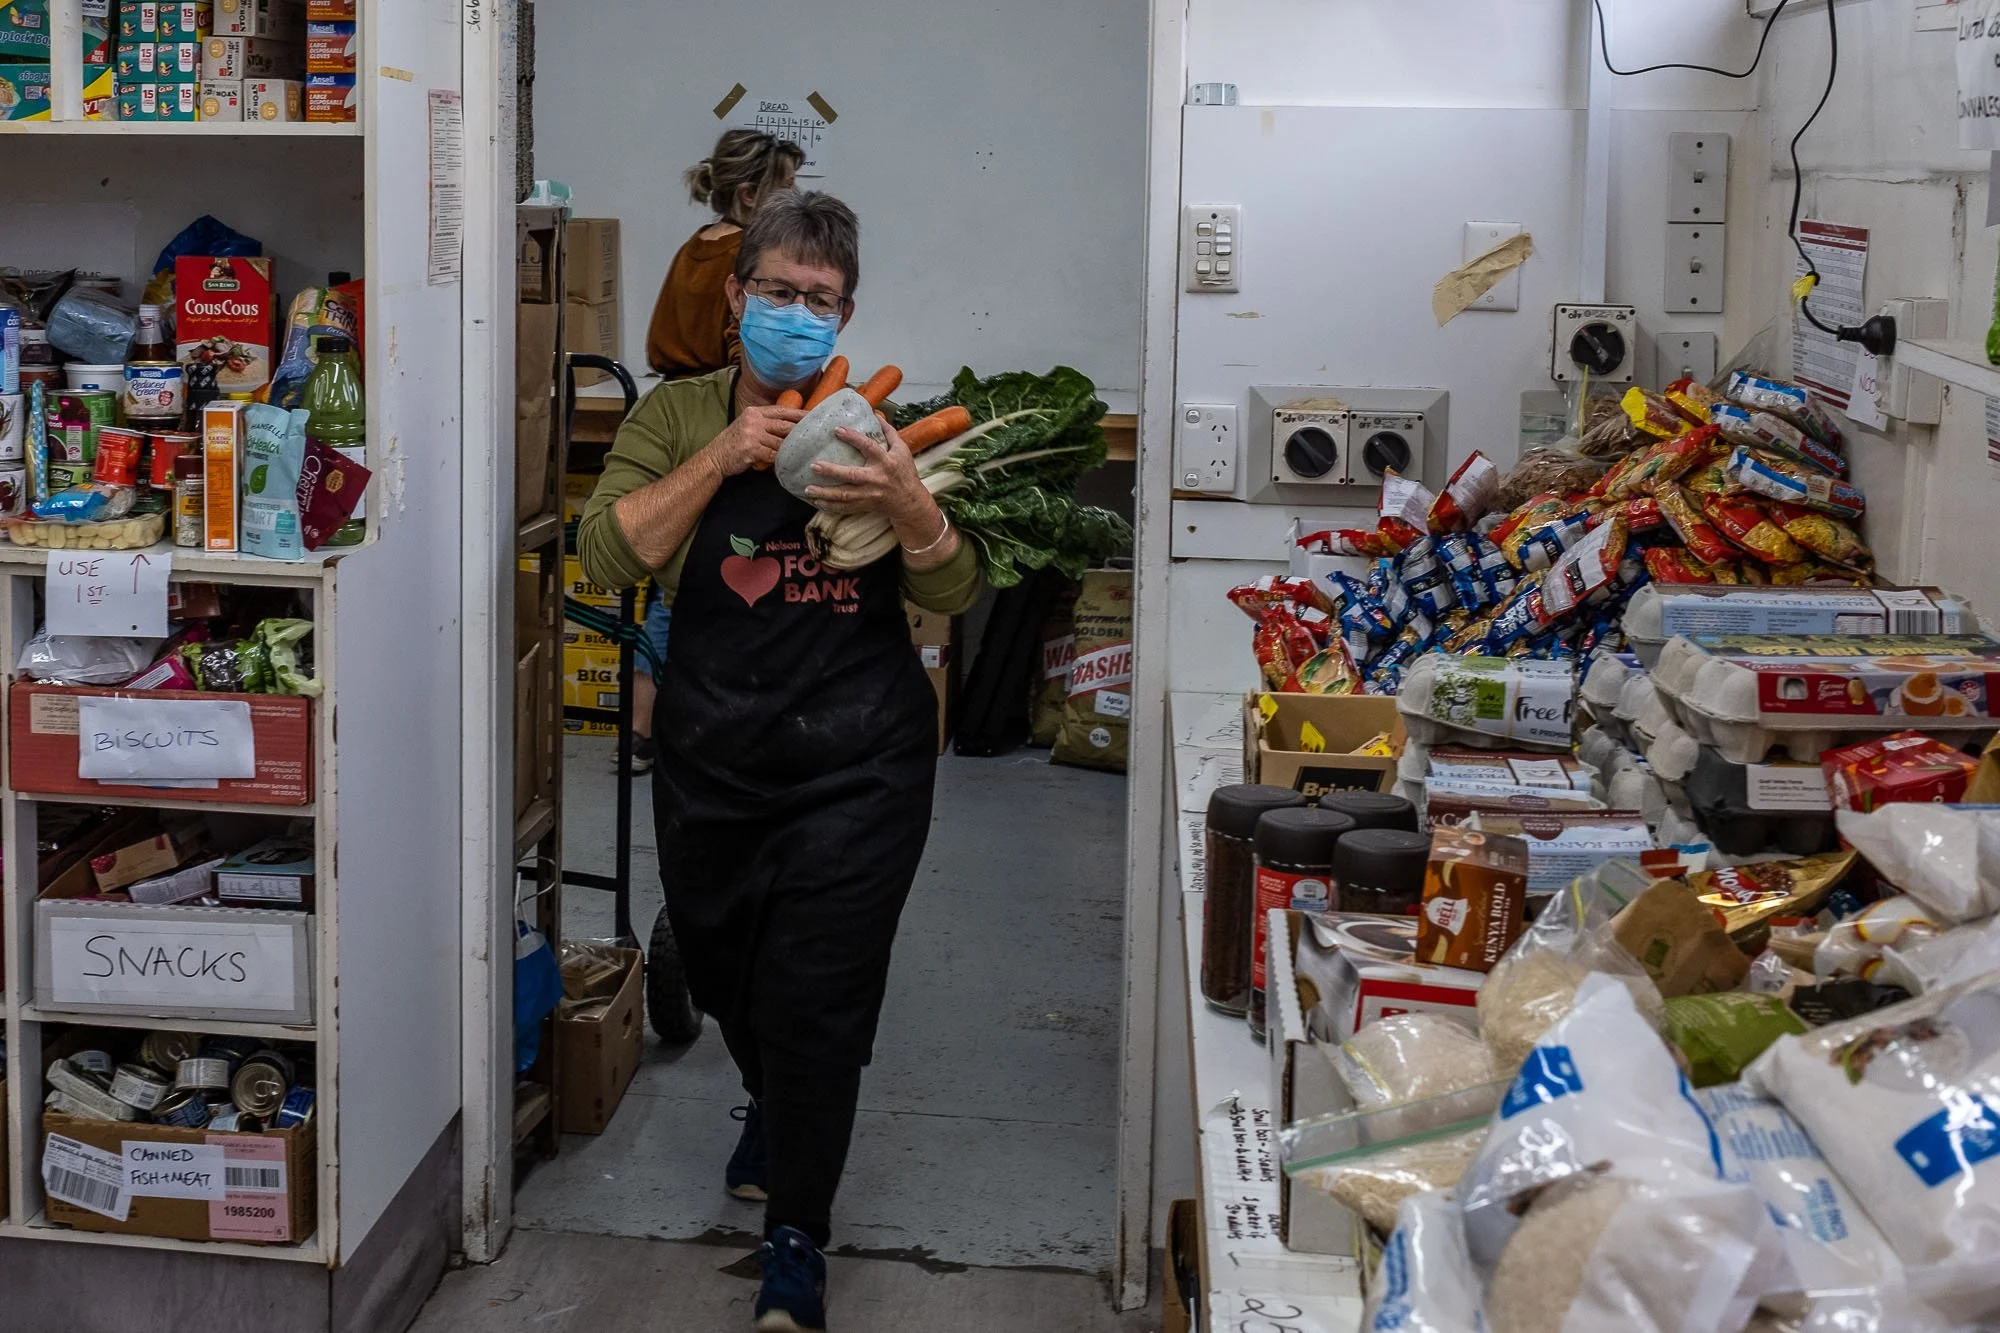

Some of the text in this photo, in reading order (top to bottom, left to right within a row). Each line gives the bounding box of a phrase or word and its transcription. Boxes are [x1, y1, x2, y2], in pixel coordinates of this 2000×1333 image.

[142, 8, 154, 18] 15
[182, 8, 194, 18] 15
[141, 48, 152, 58] 15
[180, 48, 191, 58] 15
[143, 90, 154, 99] 15
[181, 89, 192, 98] 15
[760, 101, 789, 112] BREAD
[185, 298, 259, 316] CousCous
[1568, 312, 1582, 320] OFF
[132, 380, 166, 390] Reduced
[250, 422, 286, 440] HANSELLS
[1358, 422, 1371, 430] OFF
[765, 540, 800, 552] Nelson
[58, 558, 104, 577] USE
[572, 581, 612, 596] BIG
[784, 577, 860, 603] BANK
[832, 602, 859, 614] Trust
[584, 634, 608, 644] BIG
[577, 669, 612, 682] BIG
[1514, 696, 1558, 723] Free
[590, 720, 614, 731] BIG
[1438, 900, 1456, 929] BELL
[1484, 882, 1506, 963] KENYA BOLD
[82, 934, 247, 983] SNACKS
[130, 1148, 194, 1162] CANNED
[224, 1206, 276, 1218] 1985200
